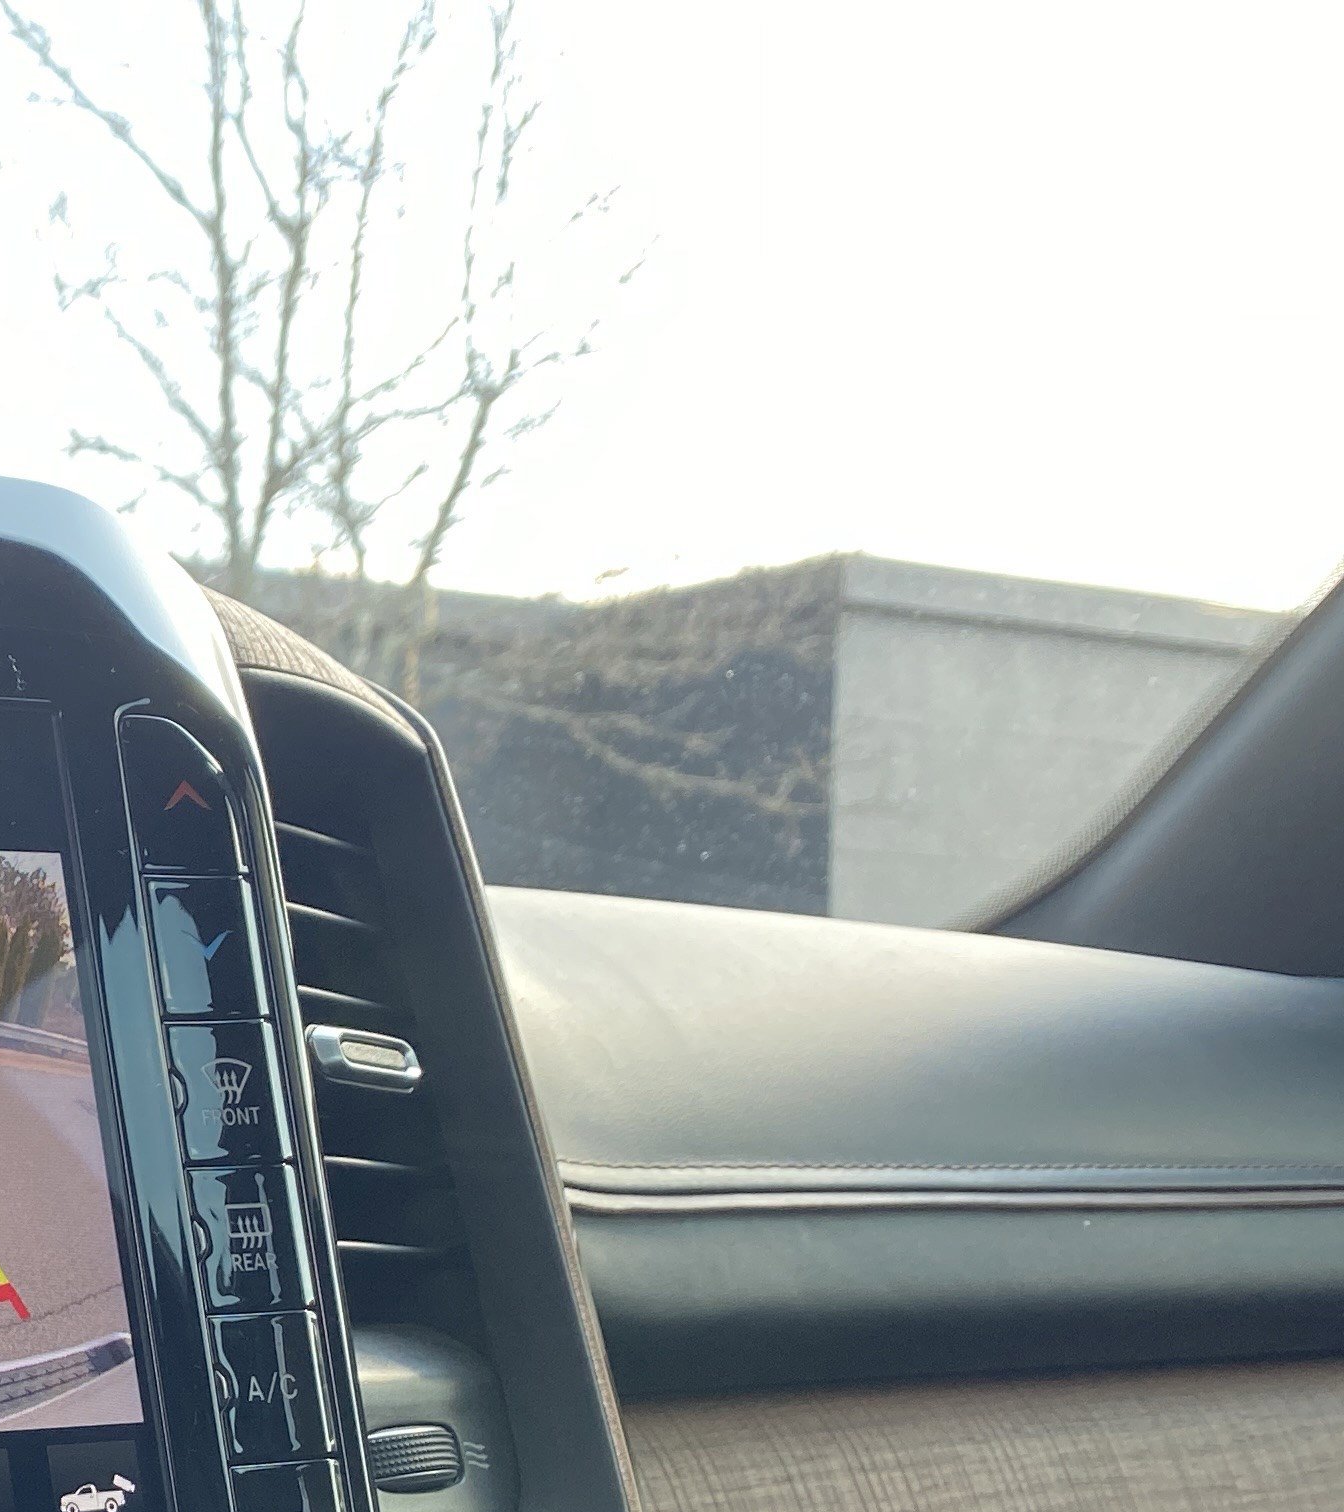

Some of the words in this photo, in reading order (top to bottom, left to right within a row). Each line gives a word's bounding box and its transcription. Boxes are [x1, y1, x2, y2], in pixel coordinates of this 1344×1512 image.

[201, 1106, 261, 1127] FRONT
[232, 1252, 278, 1273] REAR
[248, 1372, 298, 1403] A/C
